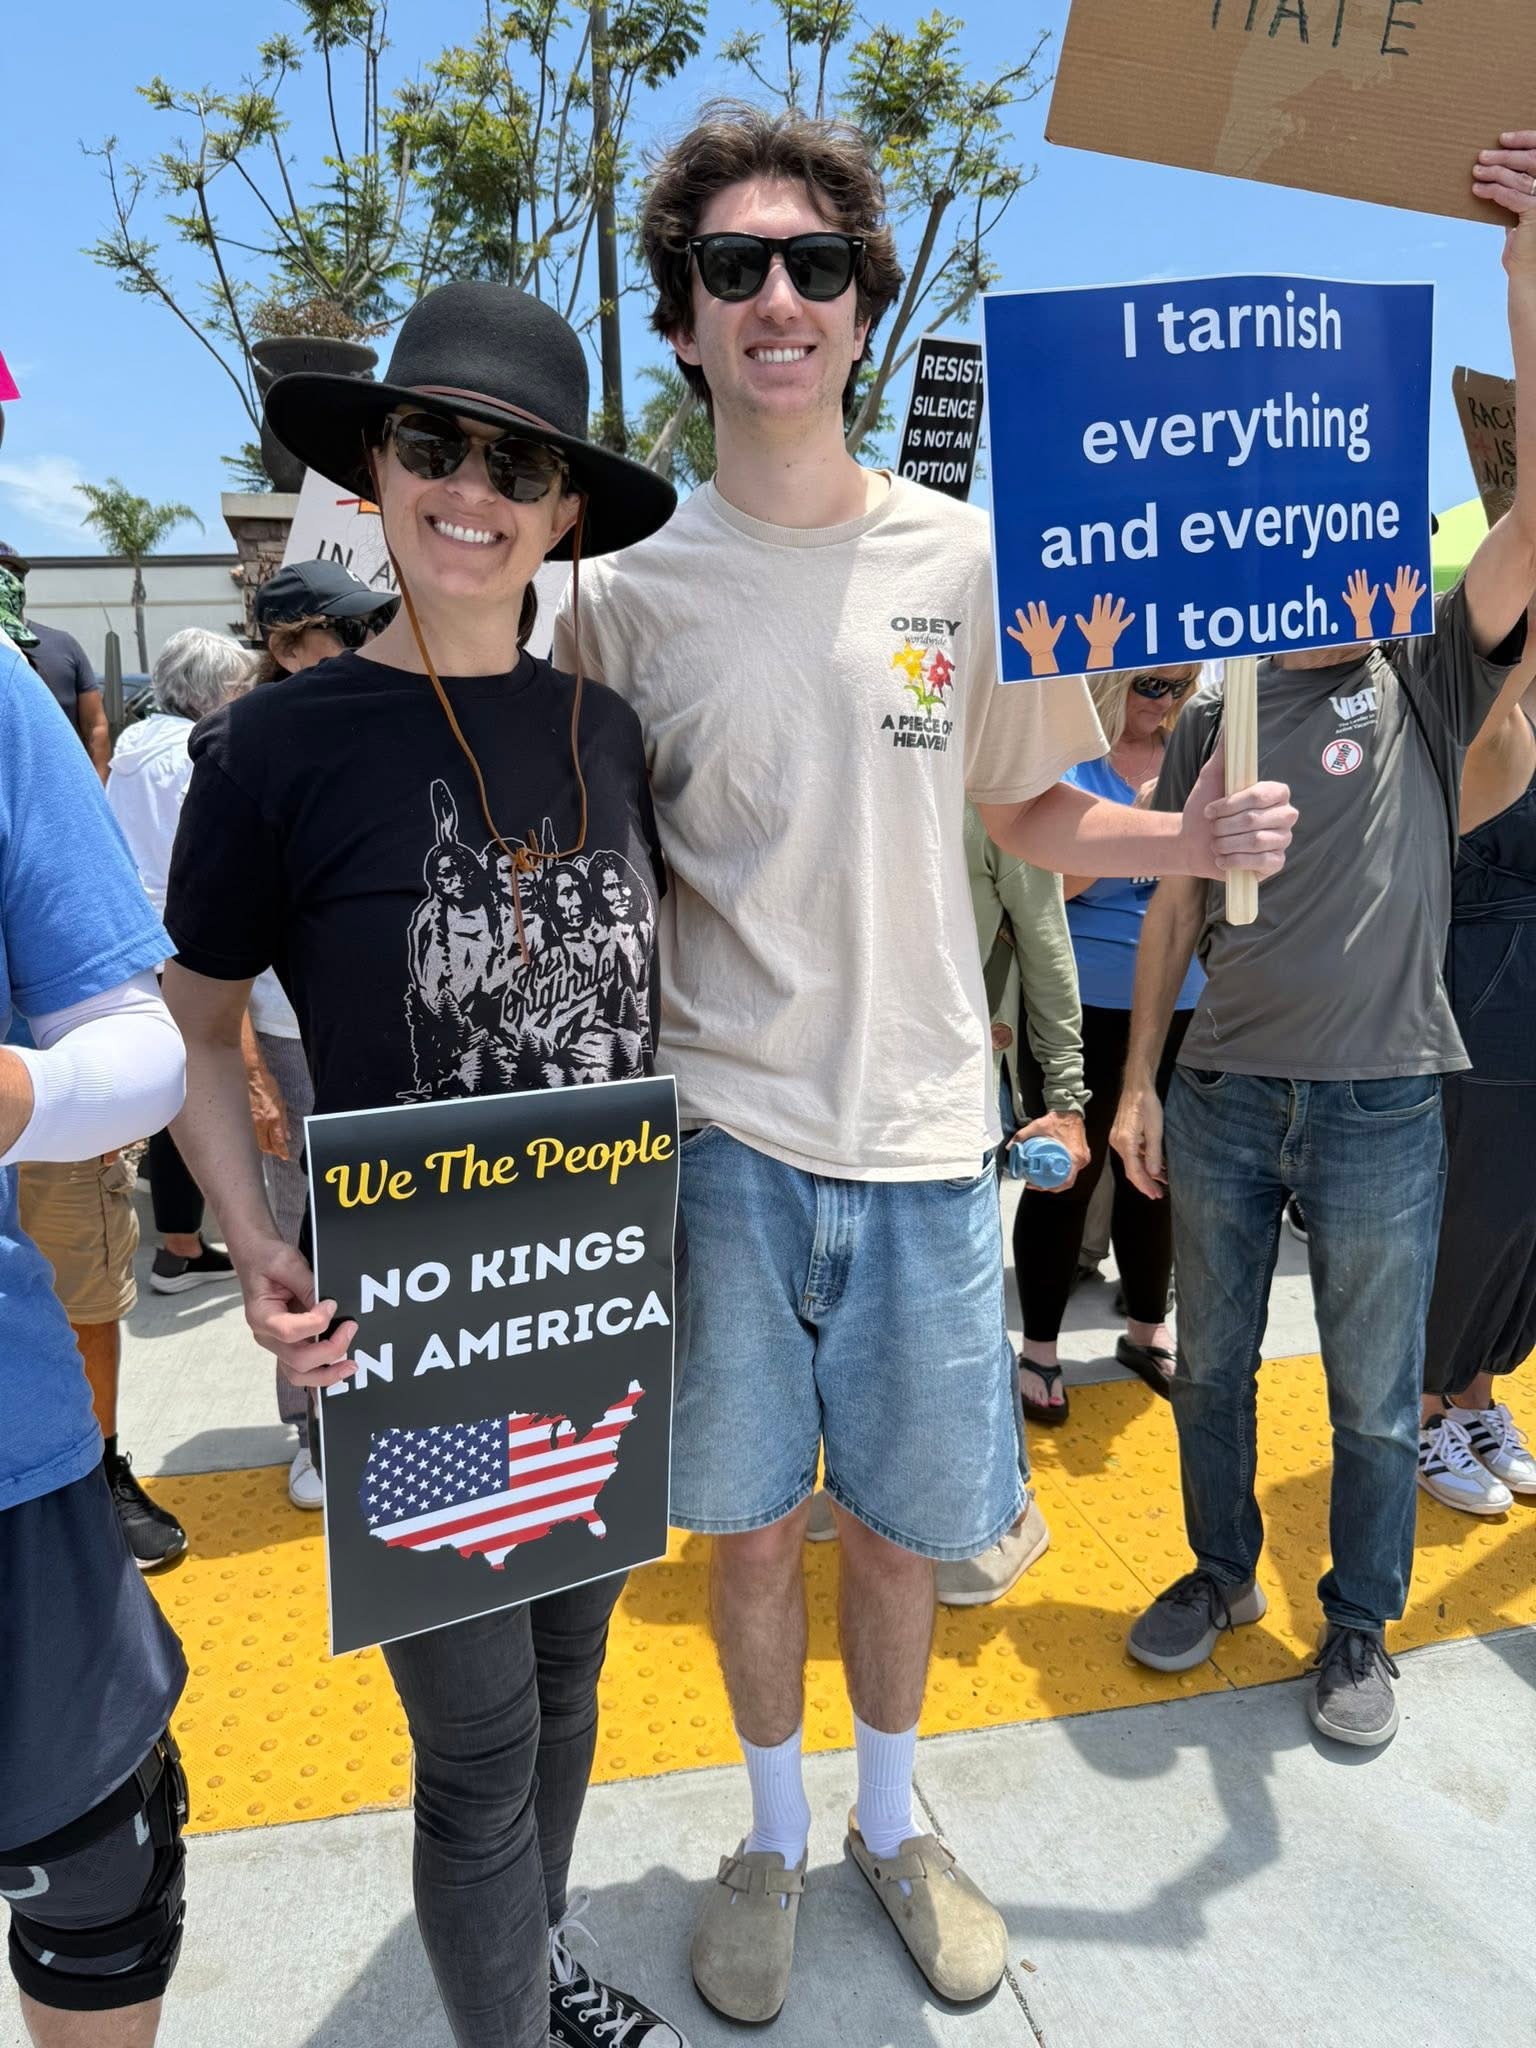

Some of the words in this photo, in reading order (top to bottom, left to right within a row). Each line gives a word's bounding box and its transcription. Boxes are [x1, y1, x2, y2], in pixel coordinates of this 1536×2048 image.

[1123, 302, 1137, 358] I
[1158, 290, 1342, 355] tarnish
[908, 429, 921, 447] IS
[924, 430, 955, 448] NOT
[954, 432, 972, 449] AN
[913, 395, 977, 419] SILENCE
[1082, 392, 1371, 467] everything
[903, 460, 967, 484] OPTION
[1041, 502, 1158, 569] and
[1180, 500, 1400, 559] everyone
[890, 617, 961, 636] OBEY
[1145, 603, 1158, 655] I
[1178, 585, 1338, 651] touch.
[880, 715, 895, 730] A
[899, 715, 941, 733] PIECE
[942, 720, 953, 736] OF
[893, 732, 947, 752] HEAVEN
[325, 1160, 416, 1208] We
[425, 1143, 518, 1193] The
[526, 1120, 674, 1185] People
[361, 1262, 450, 1314] NO
[471, 1226, 646, 1293] KINGS
[326, 1343, 393, 1396] N
[413, 1290, 670, 1376] AMERICA
